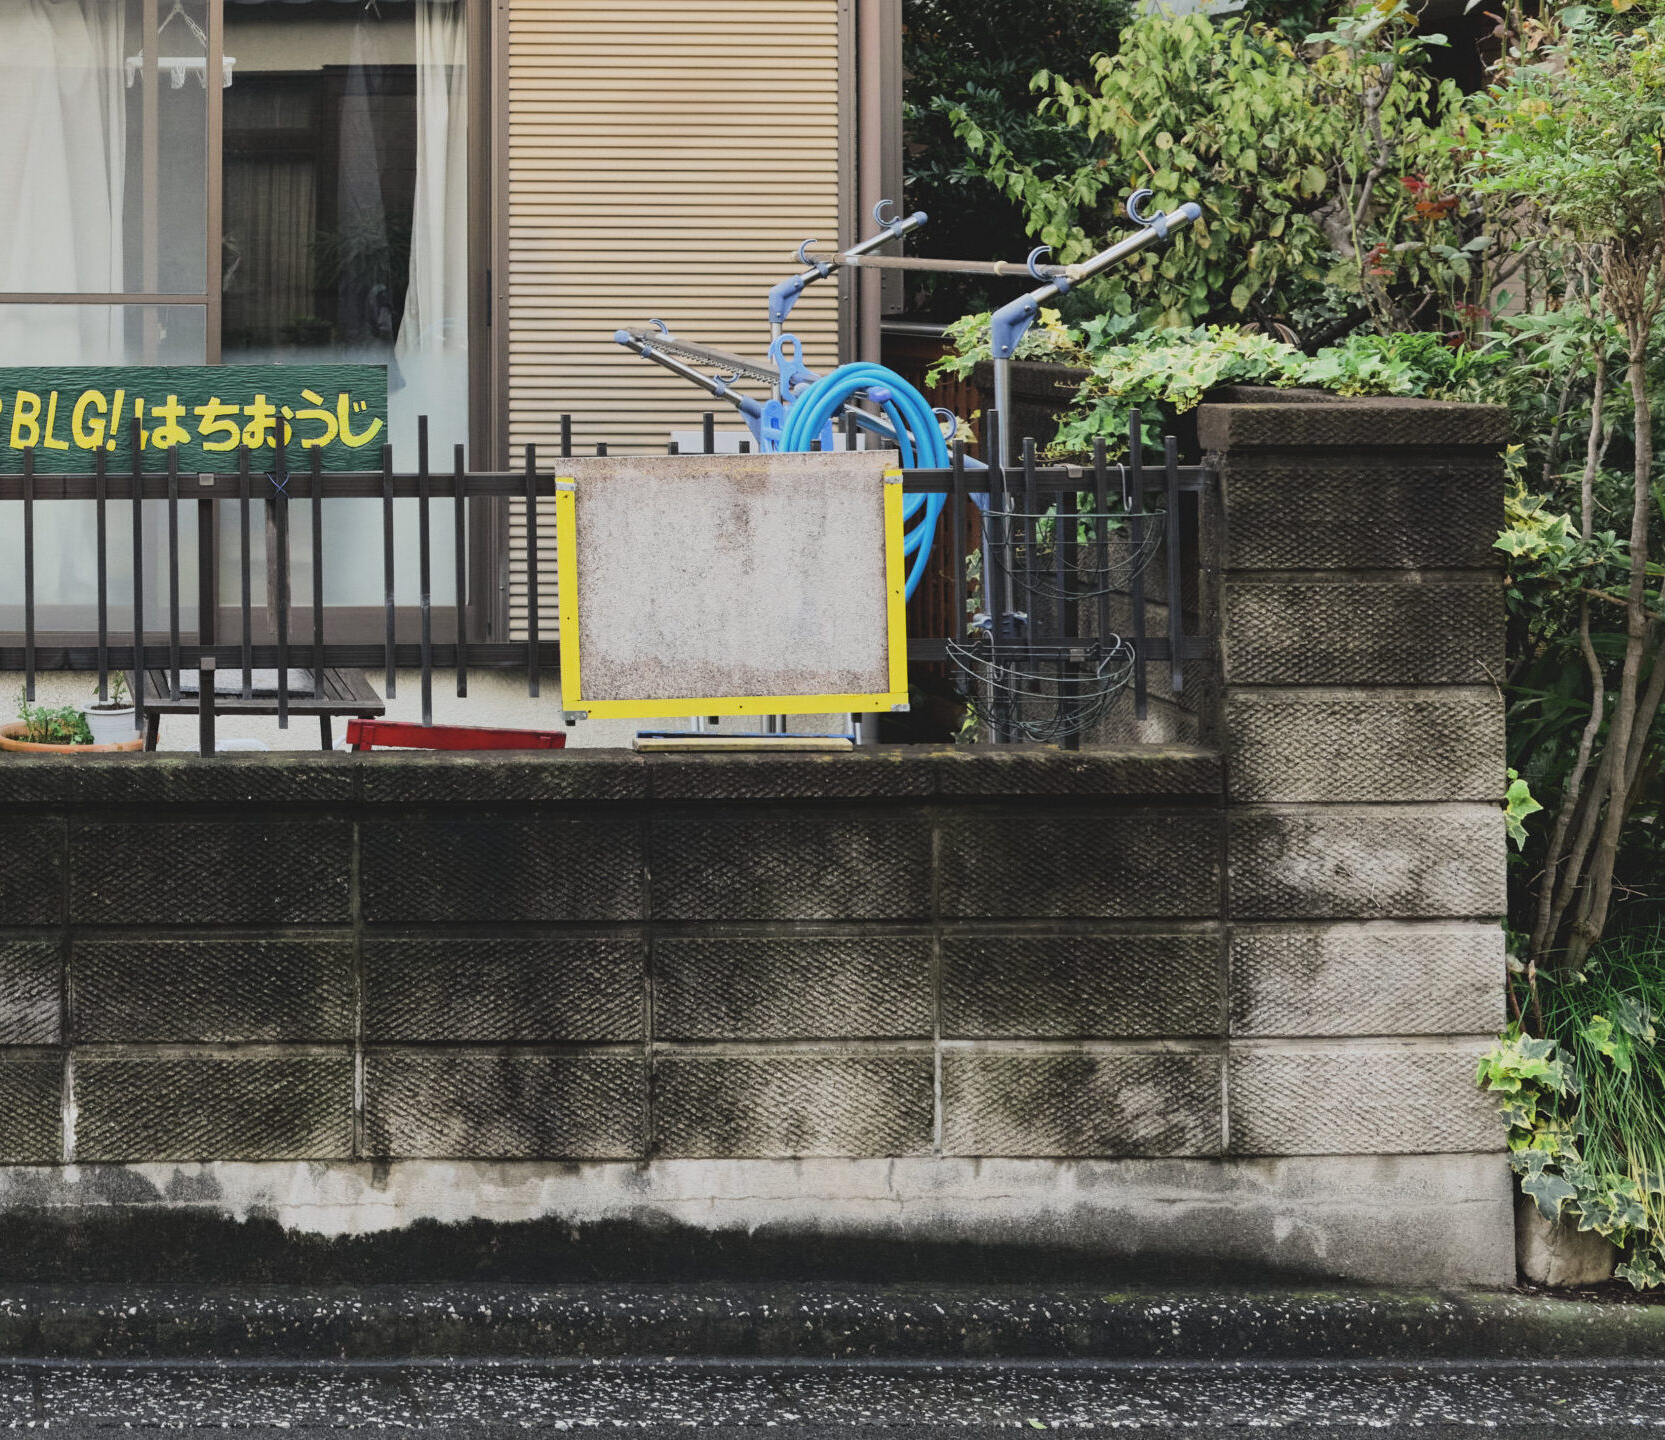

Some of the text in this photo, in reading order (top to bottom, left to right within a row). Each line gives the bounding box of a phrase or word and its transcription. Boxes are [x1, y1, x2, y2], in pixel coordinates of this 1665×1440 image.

[10, 389, 125, 452] BLG!
[134, 389, 384, 451] はちおうじ
